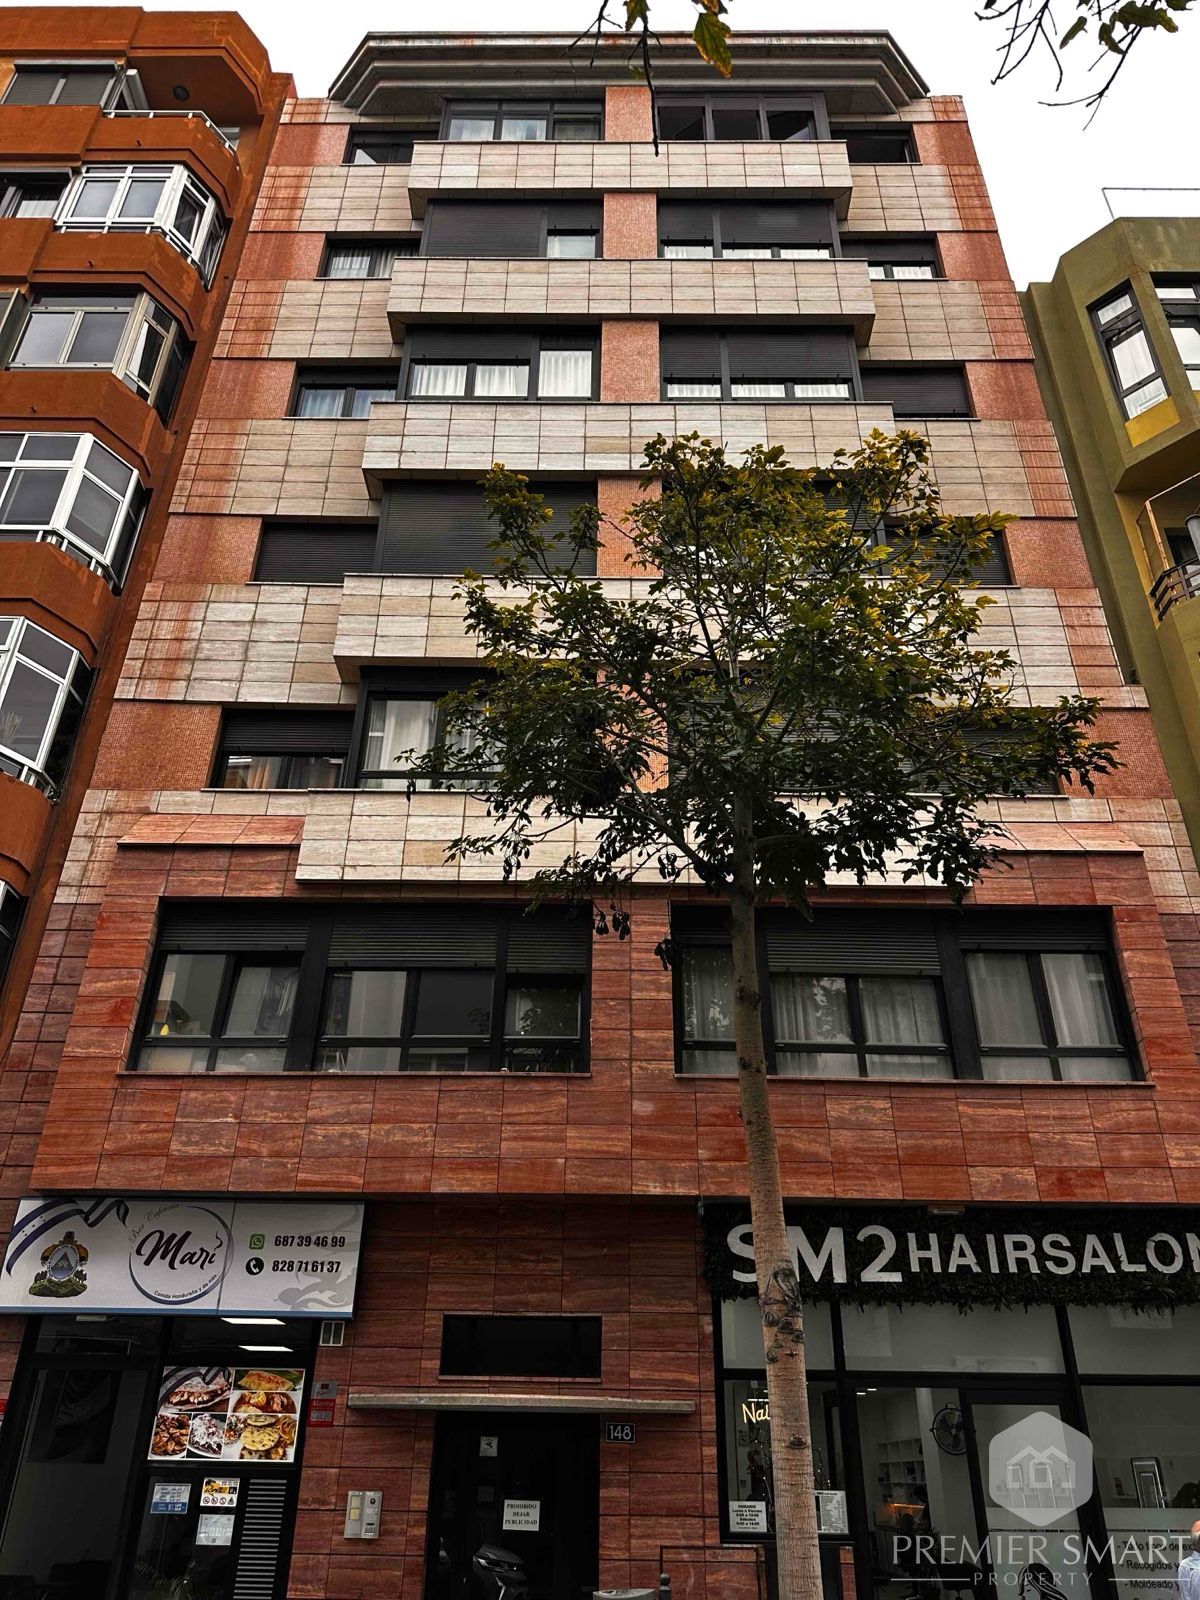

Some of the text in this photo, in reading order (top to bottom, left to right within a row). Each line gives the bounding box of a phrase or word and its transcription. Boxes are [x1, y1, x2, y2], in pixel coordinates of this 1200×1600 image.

[274, 1235, 346, 1248] 687 39 46 99
[272, 1260, 341, 1273] 828 71 61 37
[609, 1425, 632, 1440] 148
[1126, 1560, 1173, 1572] Recogidos
[1130, 1580, 1173, 1589] Moldeado
